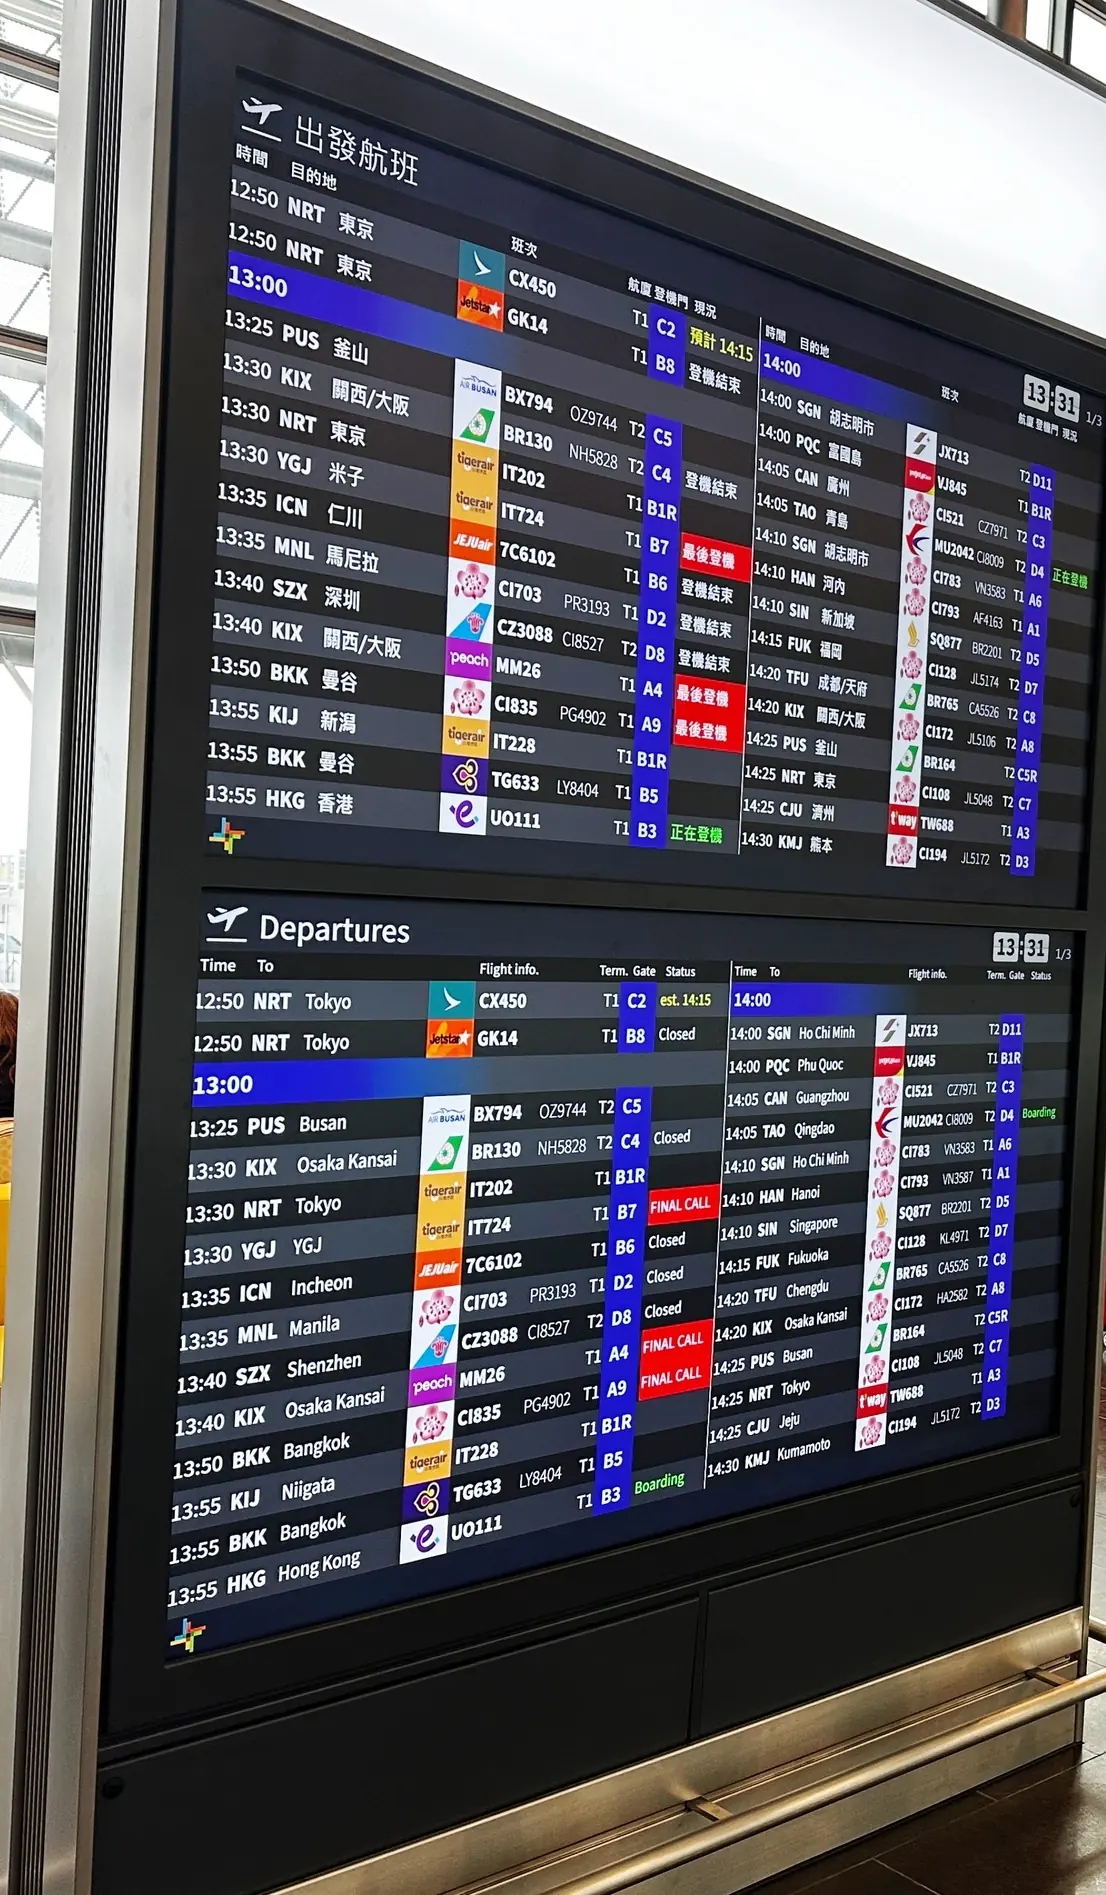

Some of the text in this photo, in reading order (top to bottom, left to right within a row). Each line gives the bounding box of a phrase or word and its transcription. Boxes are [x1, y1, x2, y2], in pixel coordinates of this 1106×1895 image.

[294, 115, 420, 187] 出發航班
[235, 143, 269, 169] 時間
[291, 161, 337, 192] 目的地
[510, 235, 538, 259] 班次
[653, 285, 689, 310] 登機門
[693, 299, 717, 320] 現況
[228, 265, 288, 298] 13:00
[230, 178, 754, 363] 12:50 NRT 東京 CX450 T1 C2 預計 14:15
[228, 222, 742, 395] 12:50 NRT 東京 Jetstar GK14 T1 B8 登機結束
[225, 309, 673, 447] 13:25 PUS 釜山 AIR BUSAN BX794 OZ9744 T2 C5
[763, 353, 801, 378] 14:00
[765, 324, 787, 344] 時間
[800, 336, 830, 359] 目的地
[941, 385, 959, 403] 班次
[1027, 380, 1102, 427] 13:31 1/3
[759, 388, 1053, 492] 14:00 SGN 胡志明市 JX713 T2 D11
[756, 492, 1088, 590] 14:05 TAO 青島 MU2042 CI8009 T2 D4 正在登機
[205, 784, 723, 845] 13:55 HKG 香港 UO111 T1 B3 正在登機
[742, 798, 1030, 840] 14:25 CJU 濟州 t'way TW688 T1 A3
[260, 914, 410, 948] Departures
[997, 938, 1072, 961] 13:31 1/3
[199, 957, 696, 978] Time To Flight info. Term. Gate Status
[734, 965, 1052, 982] Time To Flight info. Term. Gate Status
[195, 991, 712, 1015] 12:50 NRT Tokyo CX450 T1 C2 est. 14:15
[733, 992, 772, 1008] 14:00
[730, 1023, 1022, 1041] 14:00 SGN Ho Chi Minh JX713 T2 D11
[192, 1074, 254, 1095] 13:00
[187, 1128, 691, 1181] 13:30 KIX Osaka Kansai BR130 NH5828 T2 C4 Closed
[175, 1332, 704, 1437] 13:40 KIX Osaka Kansai peach MM26 T1 A4 FINAL CALL
[709, 1367, 1001, 1445] 14:25 CJU Jeju t'way TW688 T1 A3
[167, 1472, 686, 1608] 13:55 HKG Hong Kong UO111 T1 B3 Boarding
